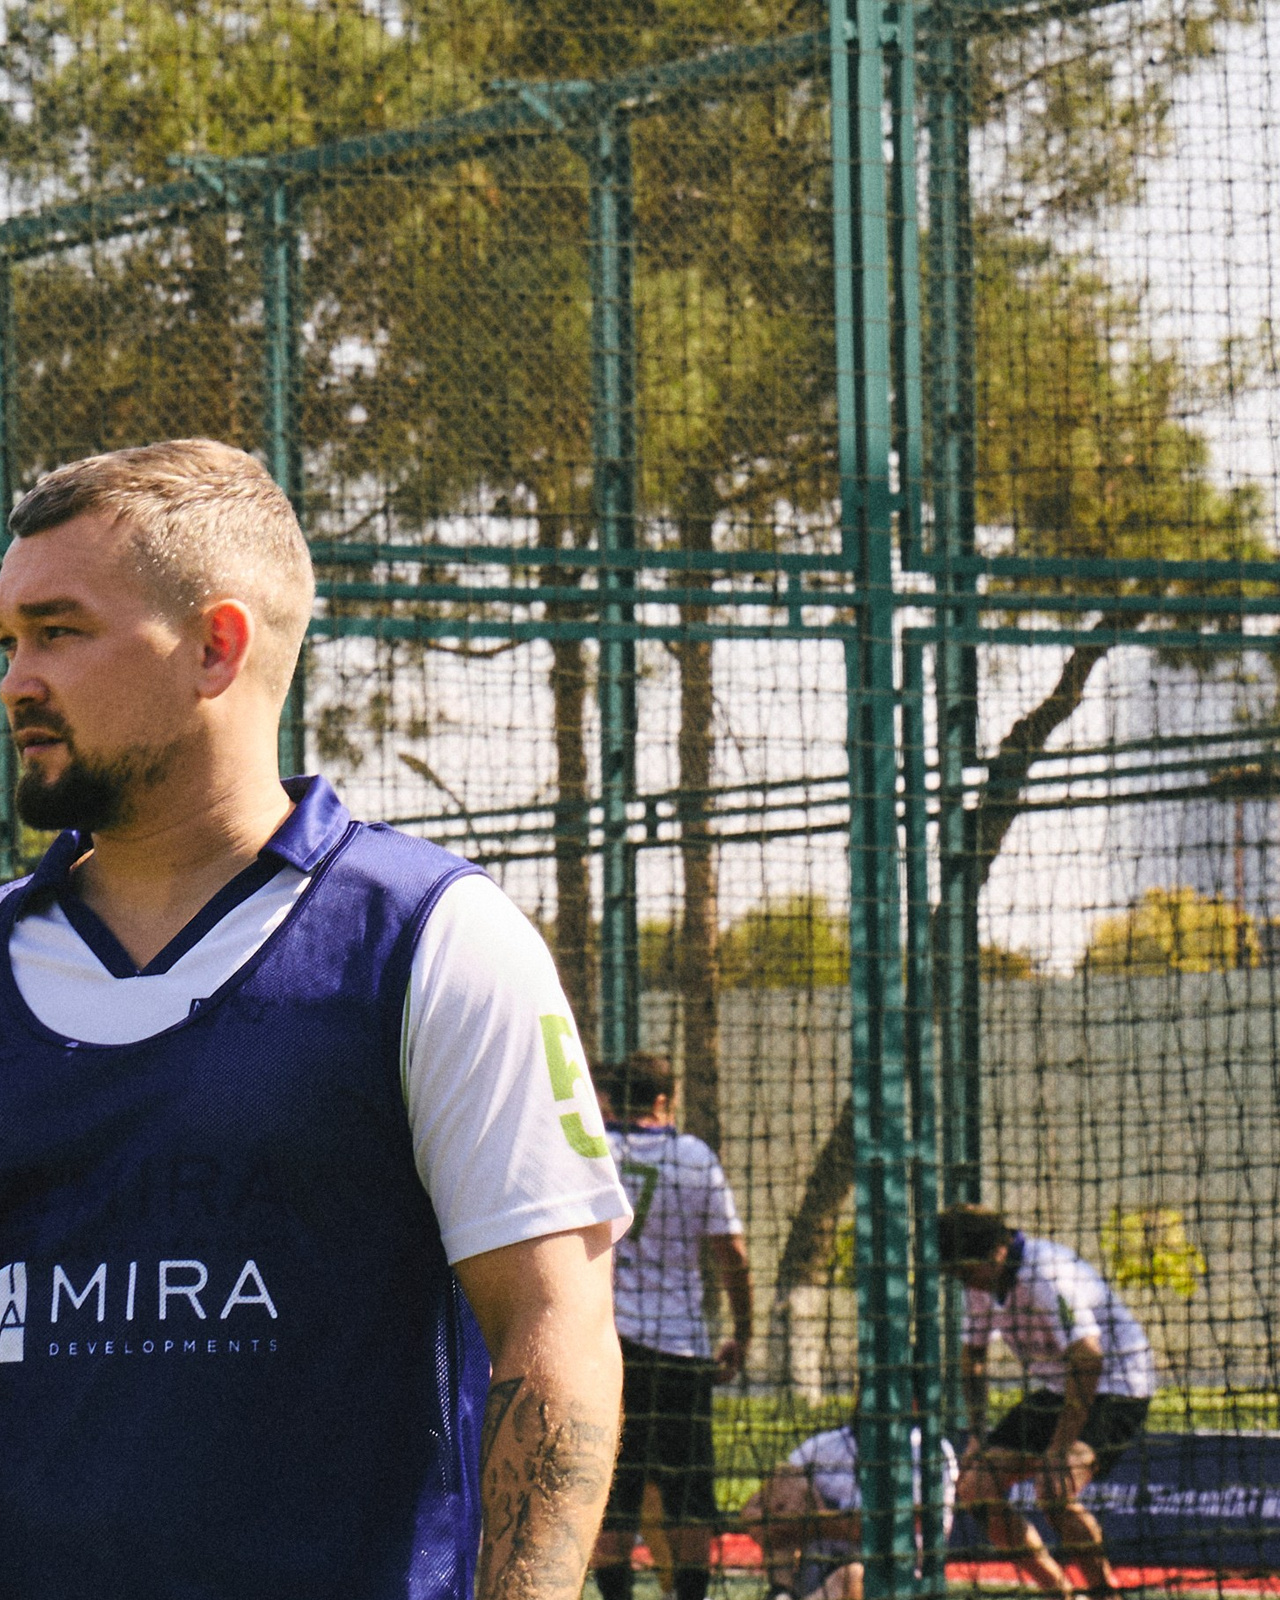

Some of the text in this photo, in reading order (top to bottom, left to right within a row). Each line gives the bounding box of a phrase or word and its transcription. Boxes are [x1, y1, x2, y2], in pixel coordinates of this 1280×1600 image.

[538, 1013, 610, 1159] 5
[622, 1162, 659, 1242] 7
[50, 1259, 278, 1323] MIRA
[48, 1338, 278, 1356] DEVELOPMENTS
